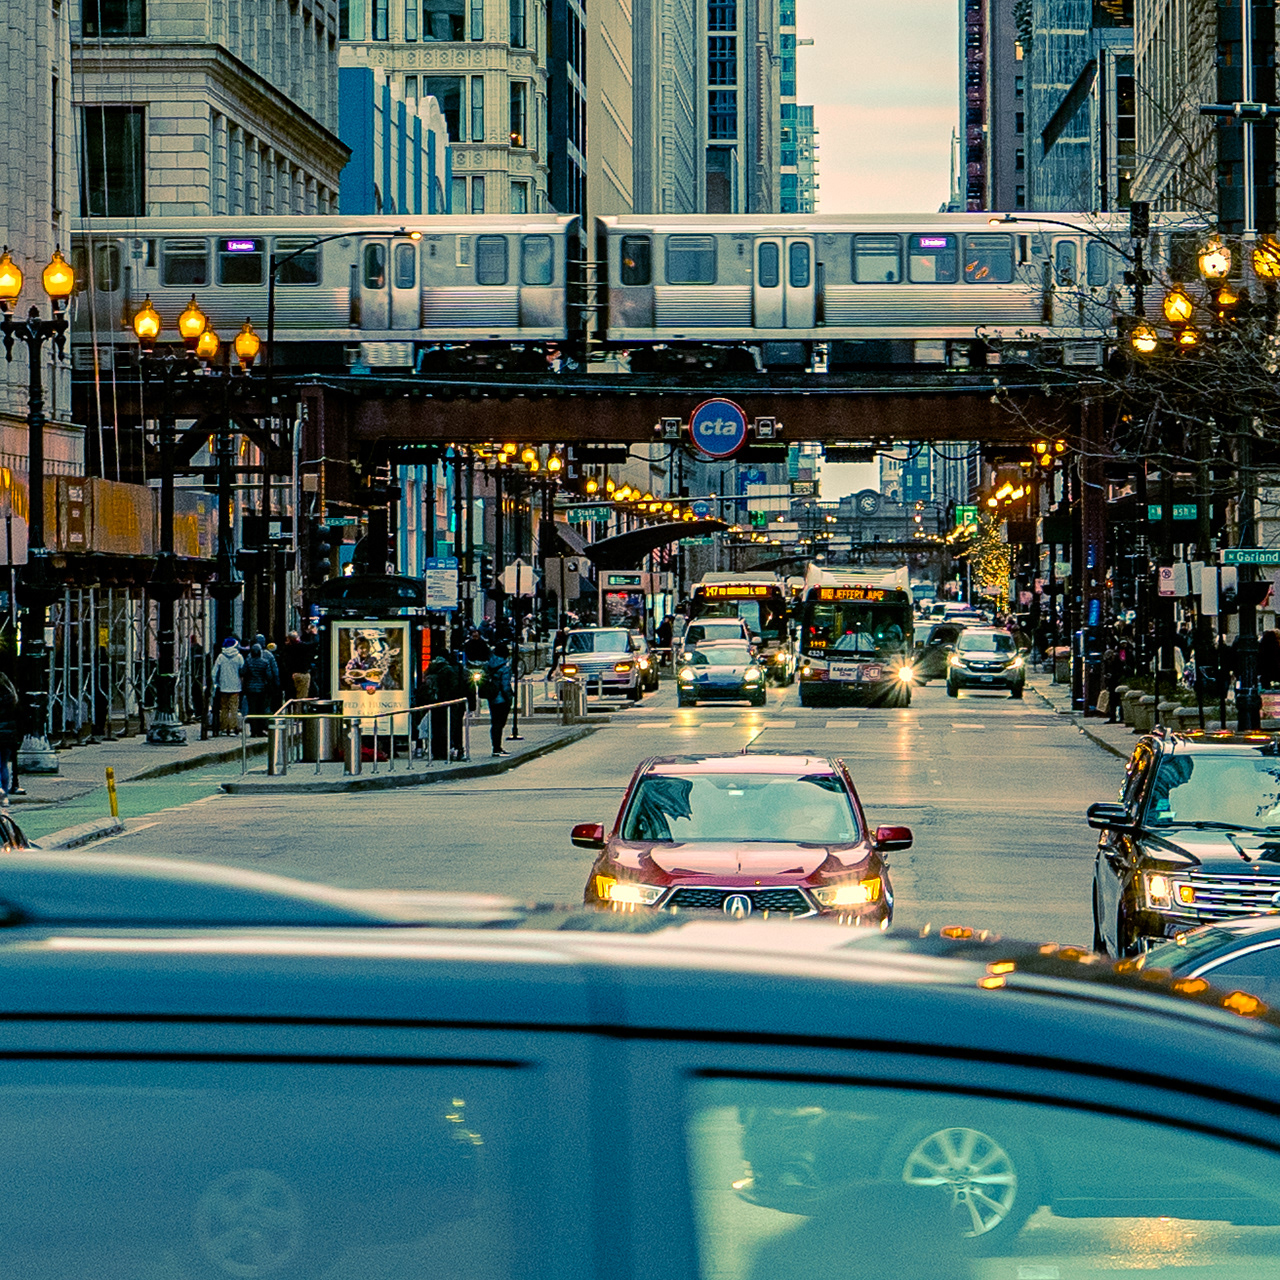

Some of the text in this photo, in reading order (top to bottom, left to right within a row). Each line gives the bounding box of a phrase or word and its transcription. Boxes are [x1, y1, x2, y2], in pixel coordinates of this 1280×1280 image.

[700, 418, 737, 436] cta
[1156, 506, 1189, 516] Wash
[1236, 551, 1279, 562] Garland
[835, 589, 865, 600] JEFFERY
